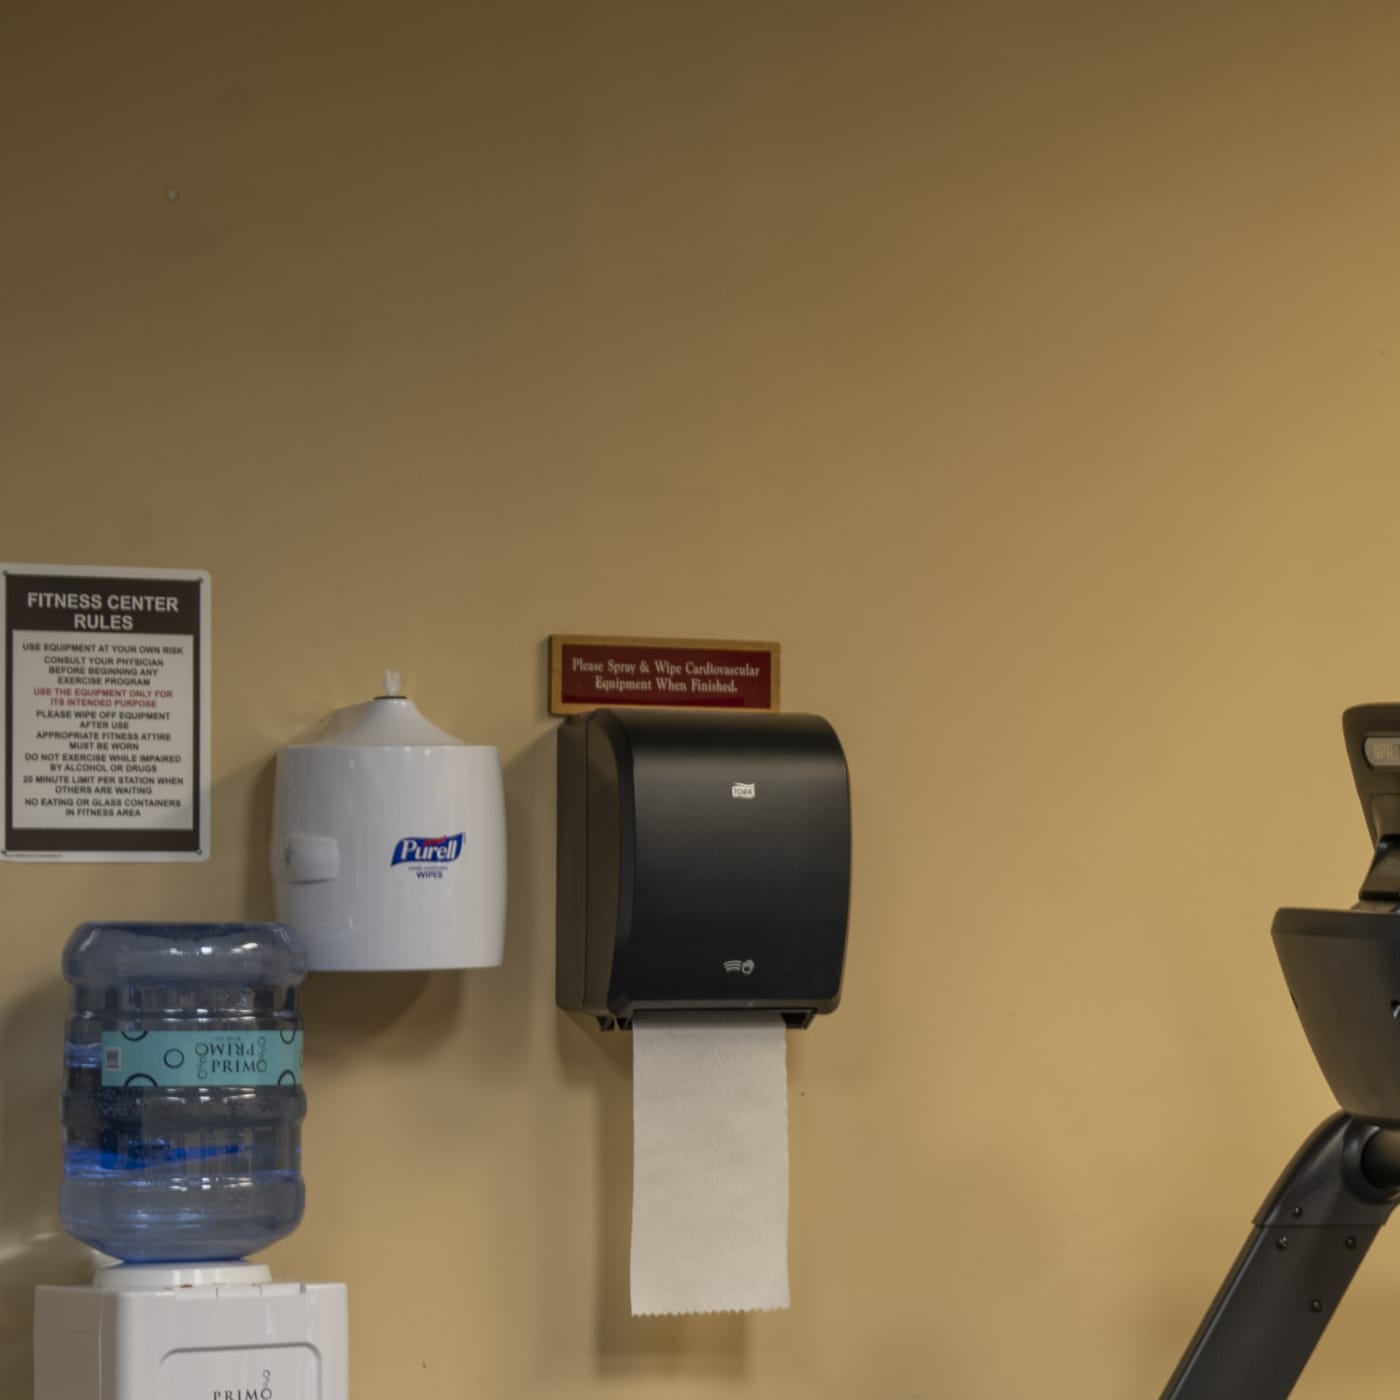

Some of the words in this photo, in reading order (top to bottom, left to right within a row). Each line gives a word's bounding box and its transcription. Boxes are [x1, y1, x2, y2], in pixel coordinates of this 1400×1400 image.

[28, 592, 101, 609] FITNESS
[108, 595, 179, 612] CENTER
[74, 614, 133, 630] RULES
[44, 644, 95, 652] EQUIPMENT
[117, 658, 163, 666] PHYSICIAN
[88, 667, 137, 675] BEGINNING
[573, 658, 603, 672] Please
[608, 659, 635, 675] Spray
[640, 661, 650, 672] &
[654, 660, 681, 676] Wipe
[685, 661, 760, 677] Cardiovascular
[105, 677, 150, 685] PROGRAM
[595, 675, 651, 691] Equipment
[656, 677, 687, 691] When
[691, 679, 738, 693] Finished.
[75, 689, 126, 697] EQUIPMENT
[155, 690, 172, 698] FOR
[67, 699, 112, 707] INTENDED
[115, 700, 156, 708] PURPOSE
[36, 710, 71, 718] PLEASE
[74, 711, 96, 719] WIPE
[100, 711, 116, 719] OFF
[119, 712, 170, 720] EQUIPMENT
[112, 721, 129, 729] USE
[36, 732, 99, 740] APPROPRIATE
[141, 733, 171, 741] ATTIRE
[62, 754, 106, 762] EXERCISE
[140, 755, 181, 763] IMPAIRED
[64, 764, 108, 772] ALCOHOL
[36, 776, 69, 784] MINUTE
[157, 777, 183, 785] WHEN
[55, 786, 92, 794] OTHERS
[92, 799, 121, 807] GLASS
[116, 809, 141, 817] AREA
[401, 839, 458, 860] Purell
[416, 871, 443, 879] WIPES
[211, 1059, 267, 1073] PRIMO
